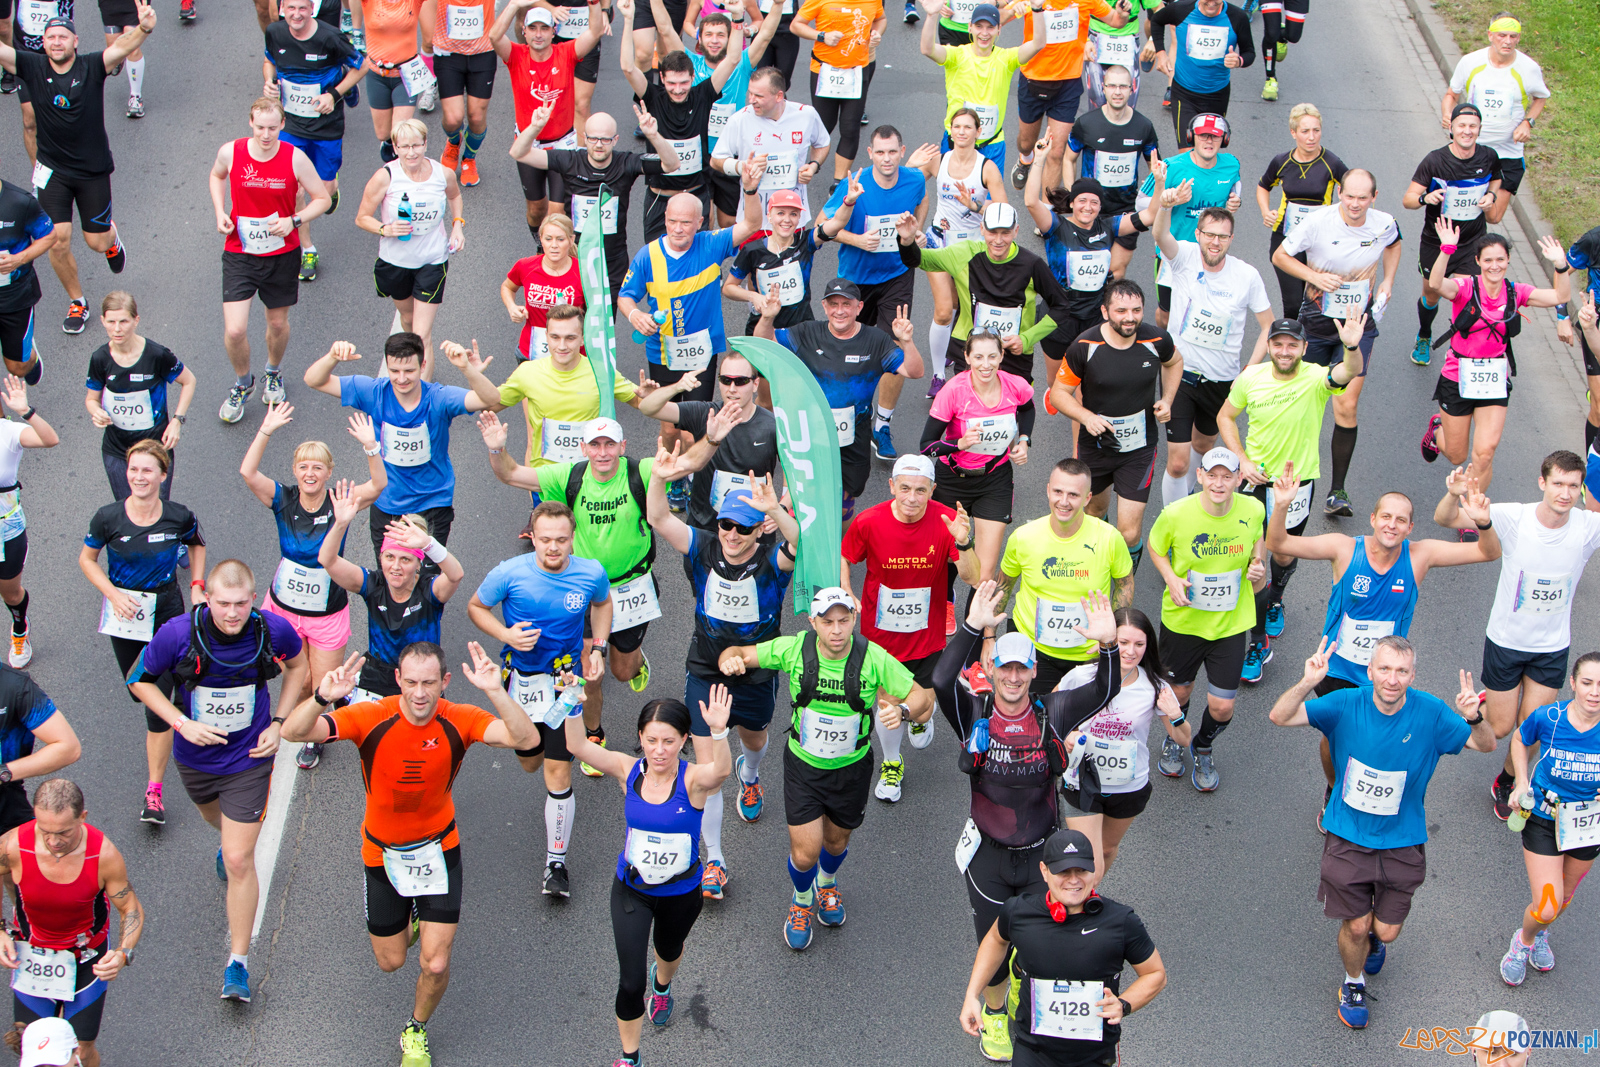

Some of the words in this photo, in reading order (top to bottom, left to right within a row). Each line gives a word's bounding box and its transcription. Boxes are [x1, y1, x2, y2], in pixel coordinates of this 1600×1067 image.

[31, 13, 50, 24] 972
[454, 17, 480, 27] 2930
[565, 17, 589, 26] 2482
[1049, 19, 1074, 30] 4583
[1106, 43, 1128, 53] 5183
[1196, 37, 1221, 48] 4537
[830, 76, 845, 85] 912
[290, 94, 313, 105] 6722
[1484, 99, 1503, 109] 329
[766, 164, 792, 176] 4517
[1103, 164, 1130, 174] 5405
[1453, 198, 1478, 208] 3814
[411, 211, 438, 222] 3247
[1078, 264, 1105, 276] 6424
[1334, 294, 1362, 304] 3310
[1192, 317, 1222, 336] 3498
[676, 346, 704, 359] 2186
[1471, 372, 1499, 383] 3578
[113, 404, 144, 417] 6970
[979, 430, 1009, 442] 1494
[394, 439, 424, 452] 2981
[554, 436, 584, 449] 6851
[1201, 545, 1228, 557] WORLD
[1229, 543, 1243, 554] RUN
[888, 557, 928, 565] MOTOR
[1050, 569, 1074, 578] WORLD
[1075, 569, 1090, 578] RUN
[287, 579, 321, 595] 5510
[1201, 586, 1232, 598] 2731
[716, 591, 750, 608] 7392
[1531, 589, 1563, 601] 5361
[618, 593, 648, 612] 7192
[887, 603, 922, 616] 4635
[206, 703, 245, 715] 2665
[1094, 721, 1129, 731] zawsze
[815, 727, 848, 742] 7193
[1356, 779, 1394, 799] 5789
[642, 850, 678, 866] 2167
[405, 863, 433, 876] 773
[26, 958, 67, 979] 2880
[1049, 1001, 1090, 1017] 4128
